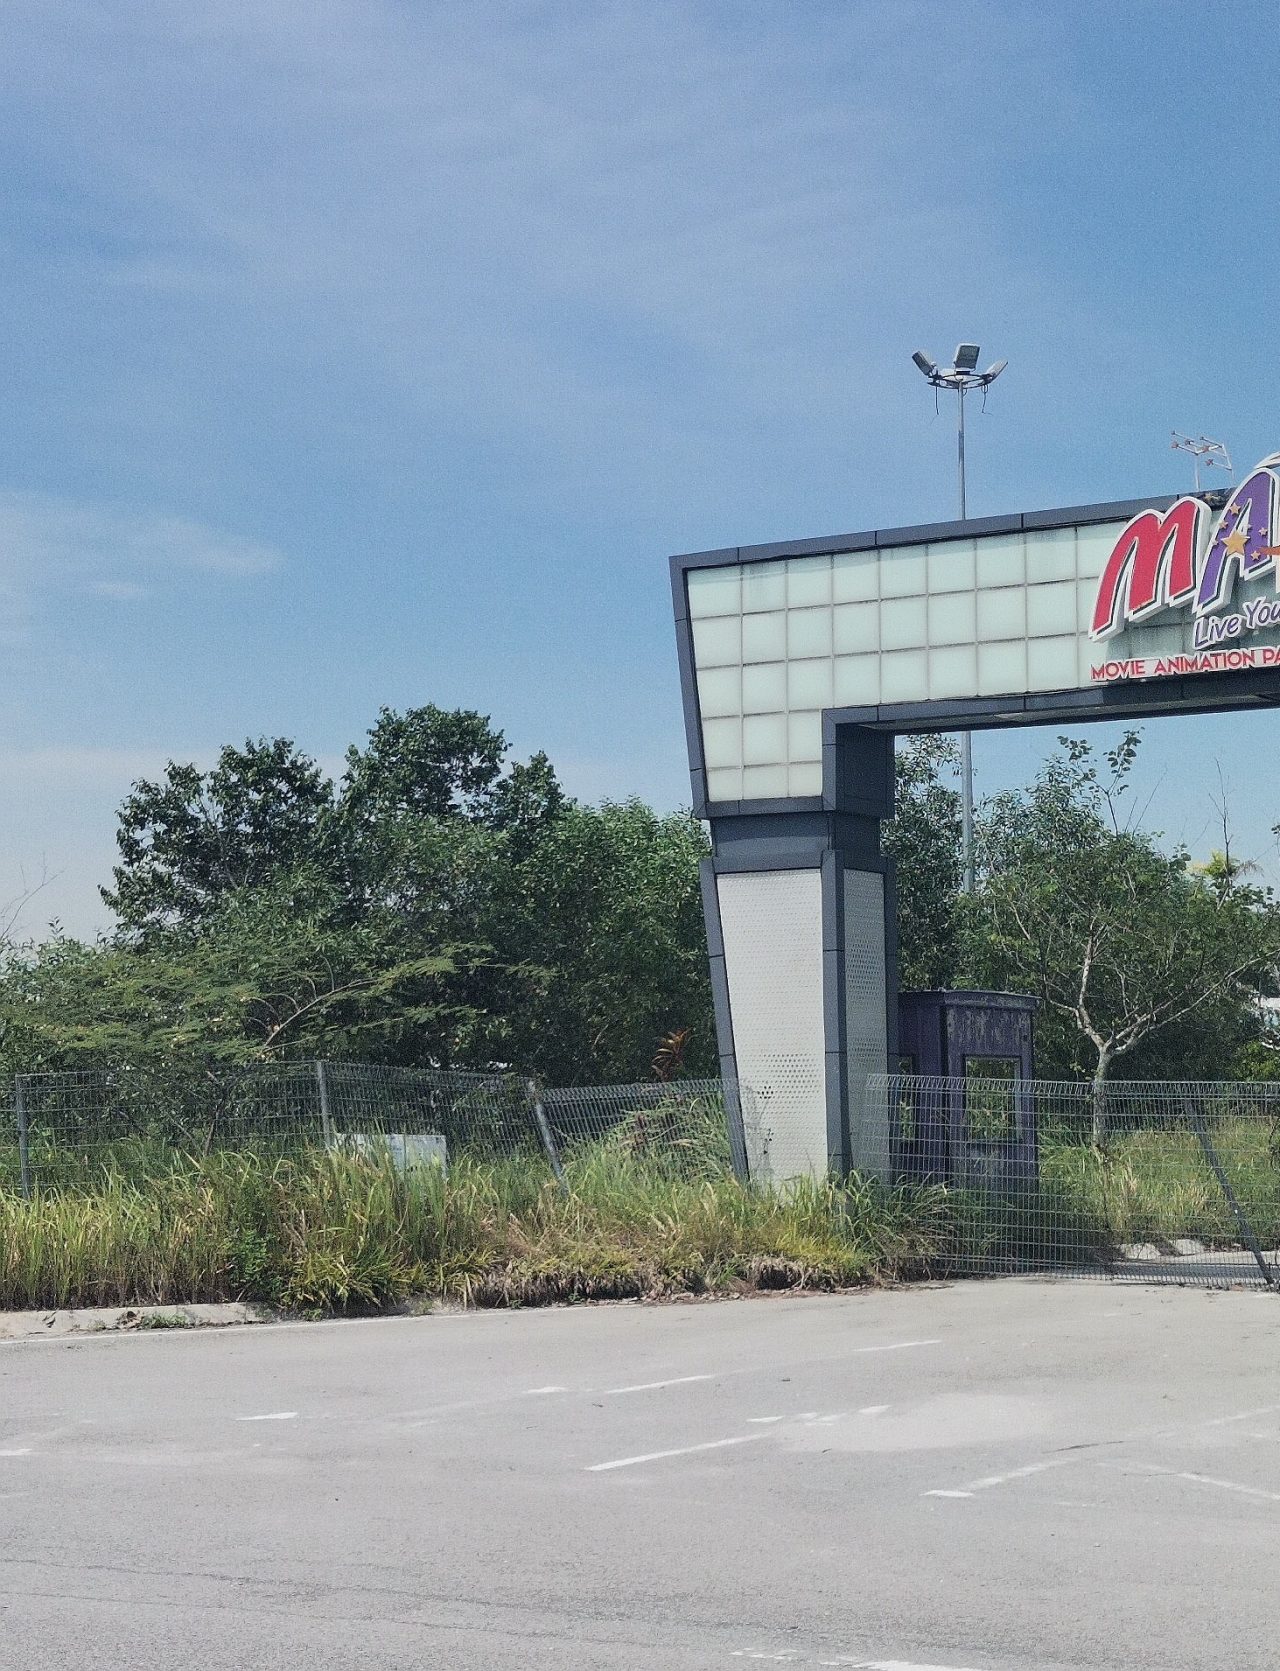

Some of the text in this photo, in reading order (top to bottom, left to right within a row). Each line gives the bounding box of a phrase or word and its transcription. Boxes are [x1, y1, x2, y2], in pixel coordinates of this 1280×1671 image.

[1194, 616, 1242, 647] Live
[1091, 660, 1146, 681] MOVIE
[1154, 649, 1256, 676] ANIMATION
